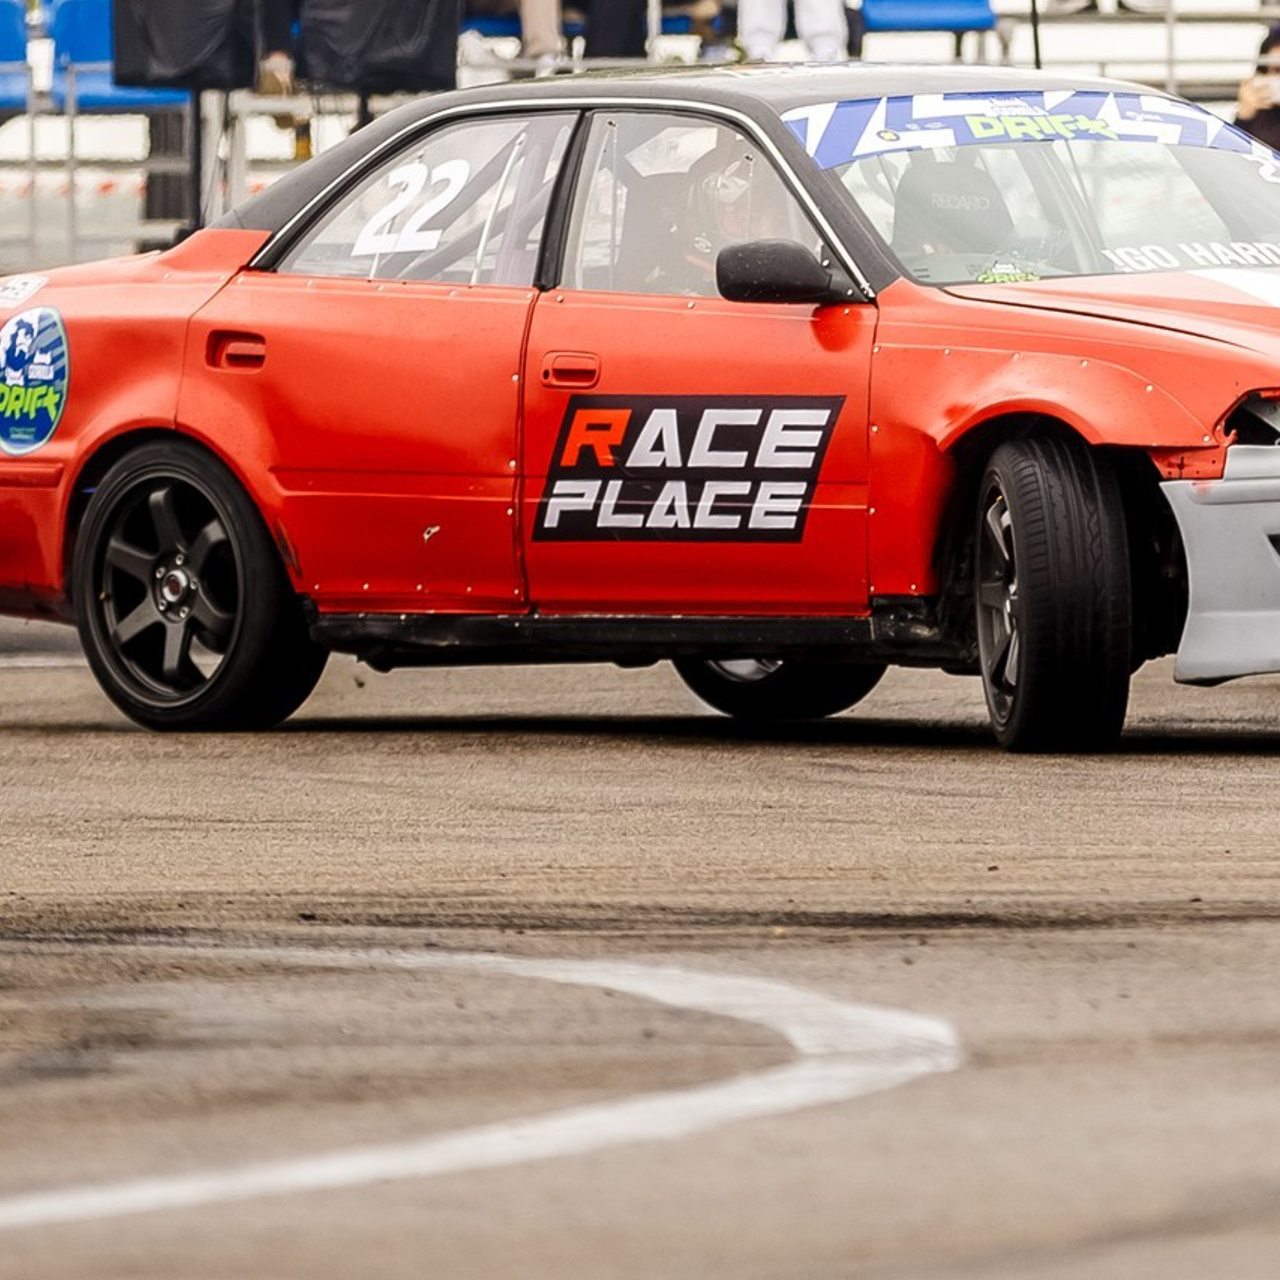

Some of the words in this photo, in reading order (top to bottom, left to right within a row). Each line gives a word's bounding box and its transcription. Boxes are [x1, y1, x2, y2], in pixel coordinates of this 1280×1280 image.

[965, 115, 1118, 140] DRIFT
[351, 158, 470, 257] 22
[931, 194, 990, 211] RECARO
[560, 409, 831, 468] RACE
[543, 480, 807, 529] PLACE
